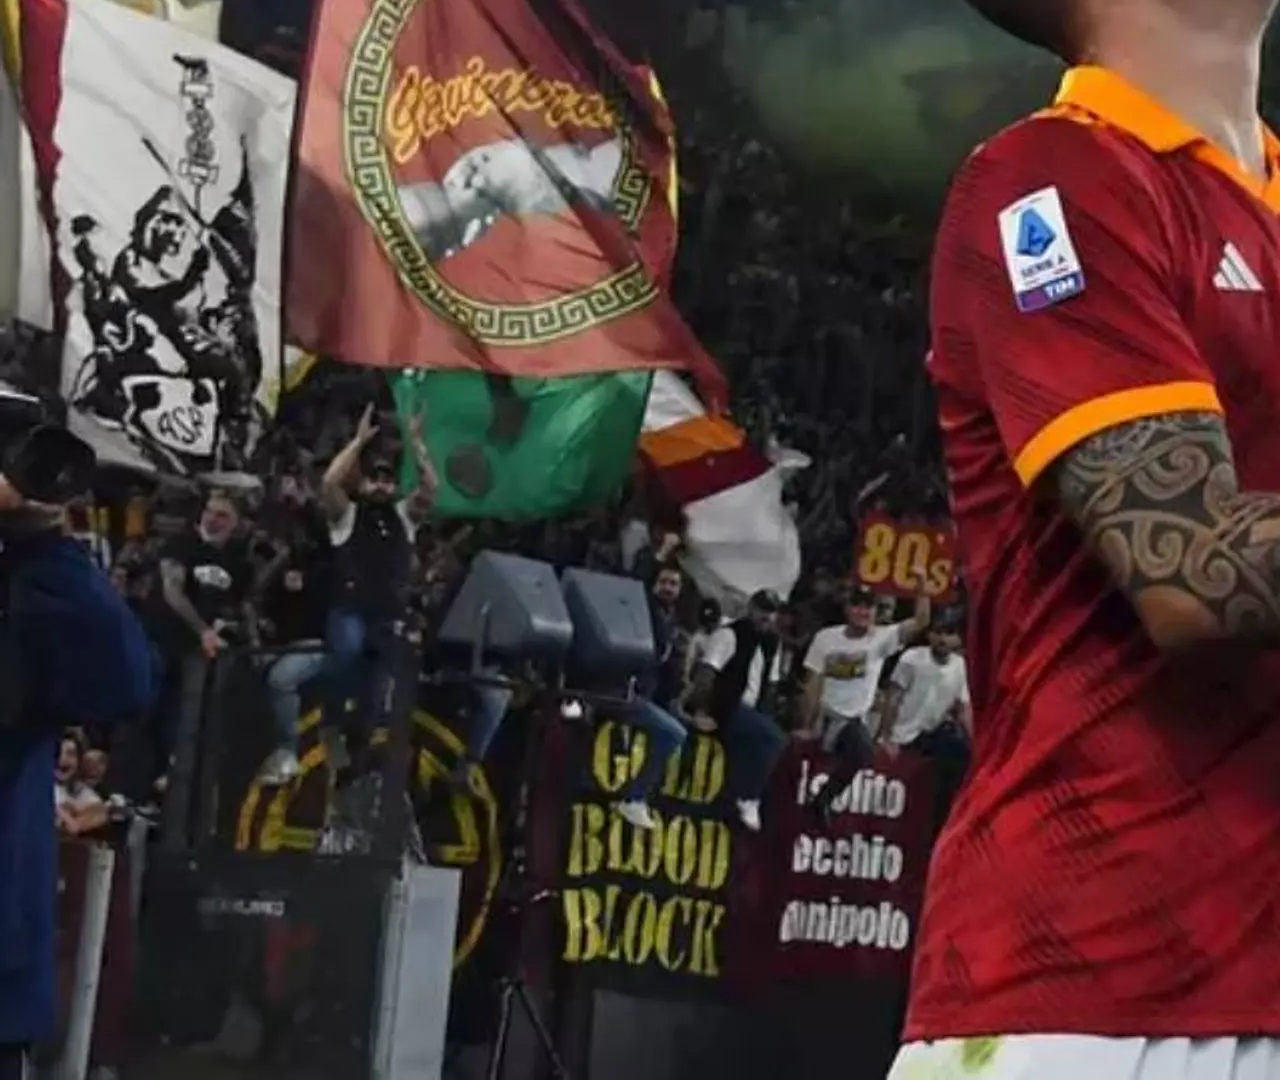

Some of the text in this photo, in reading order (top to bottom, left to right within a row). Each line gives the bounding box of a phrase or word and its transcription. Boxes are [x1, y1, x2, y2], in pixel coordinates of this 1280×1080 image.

[593, 721, 726, 803] GLD
[566, 803, 732, 889] BLOOD
[563, 884, 726, 977] BLOCK
